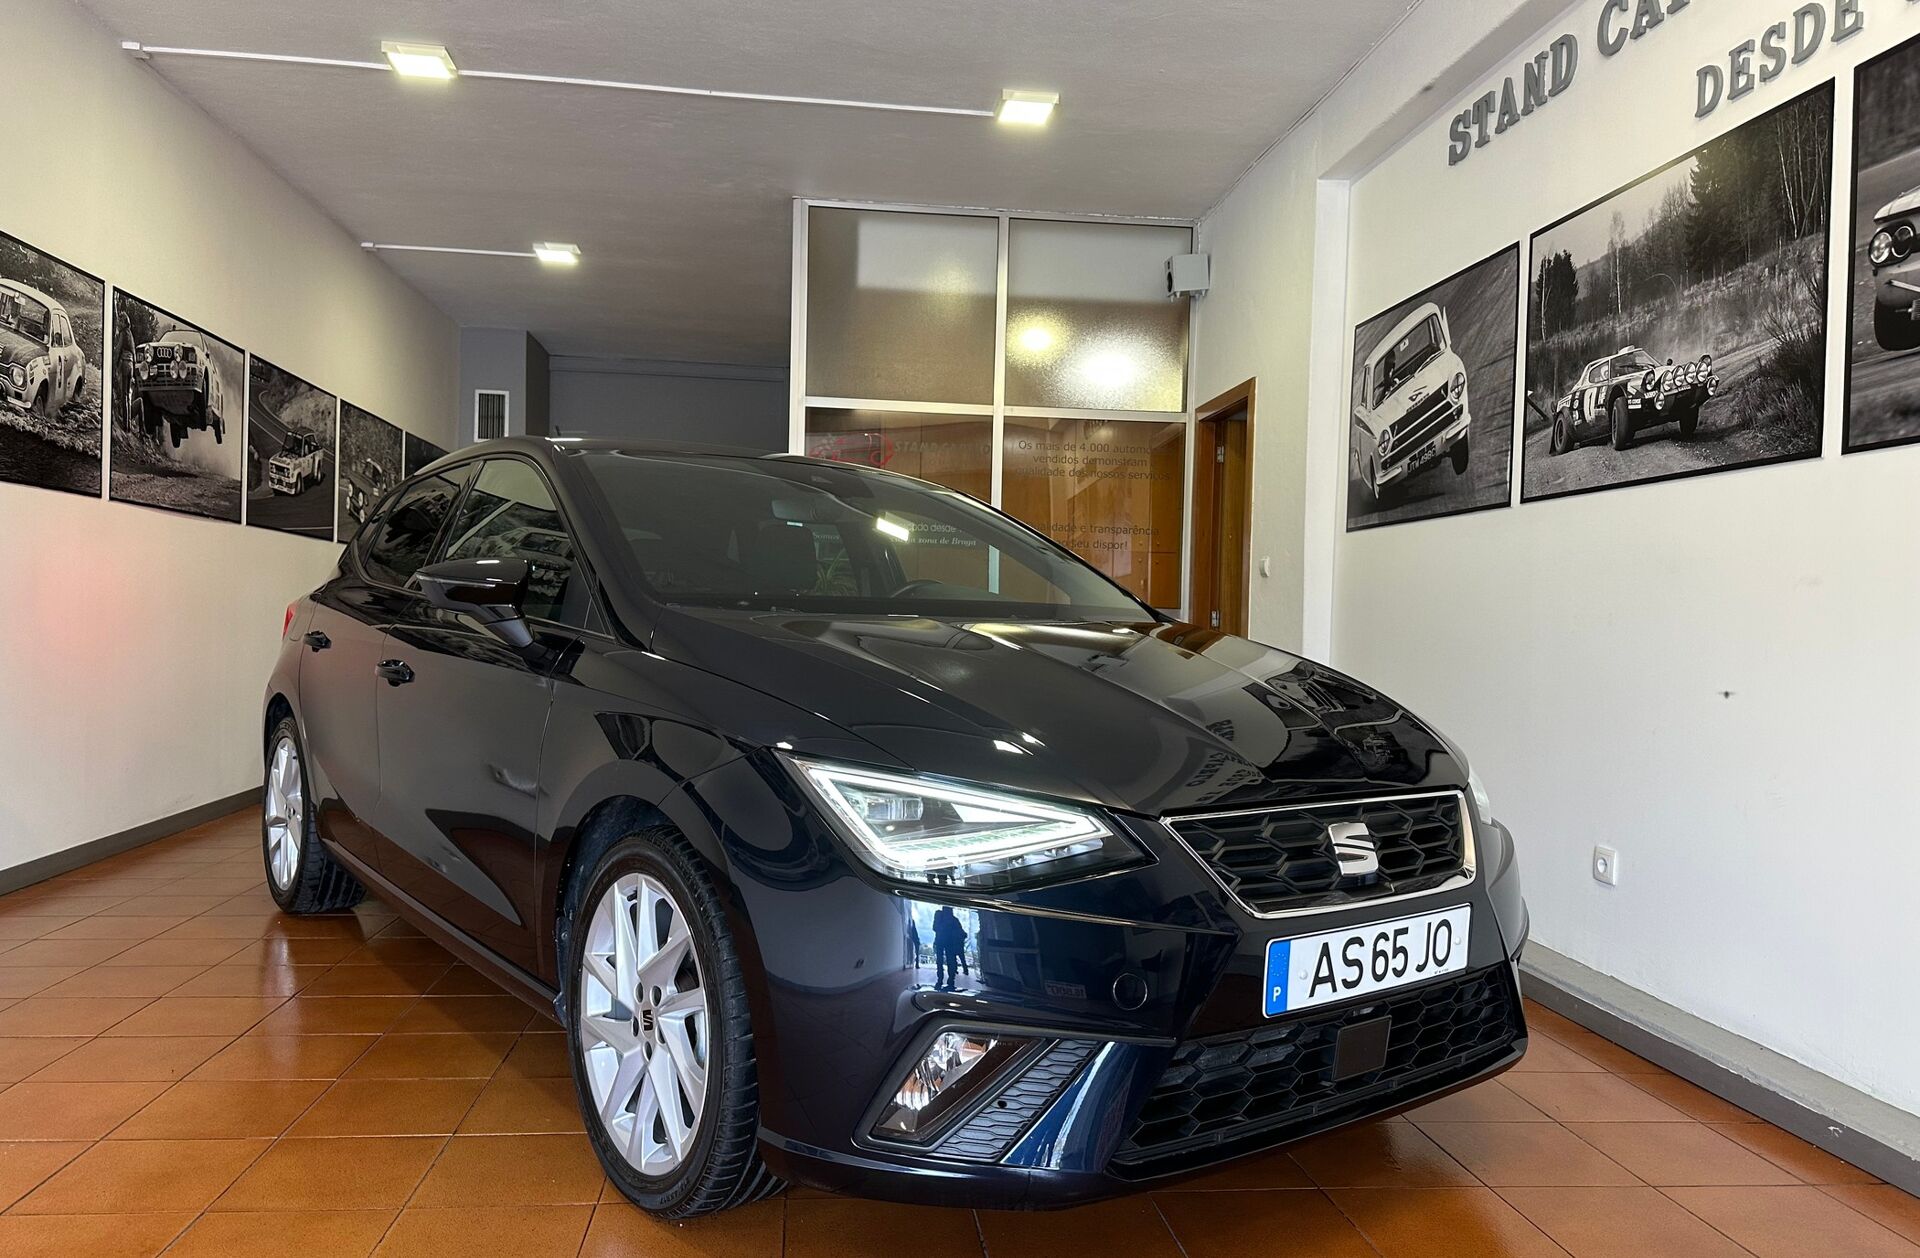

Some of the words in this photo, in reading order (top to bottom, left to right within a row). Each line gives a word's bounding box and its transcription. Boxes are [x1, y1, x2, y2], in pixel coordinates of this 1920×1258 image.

[1694, 0, 1864, 119] DESDE
[1448, 33, 1579, 166] STAND
[1597, 0, 1691, 57] CA
[1018, 440, 1033, 450] Os
[1036, 440, 1060, 451] mais
[1063, 441, 1077, 452] de
[1079, 442, 1110, 453] 4.000
[1032, 454, 1079, 464] vendidos
[1082, 455, 1148, 467] demonstram
[1069, 467, 1086, 478] dos
[1088, 469, 1124, 479] nossos
[1090, 524, 1160, 536] transparência
[1093, 539, 1128, 551] dispor!
[1272, 986, 1282, 1003] P
